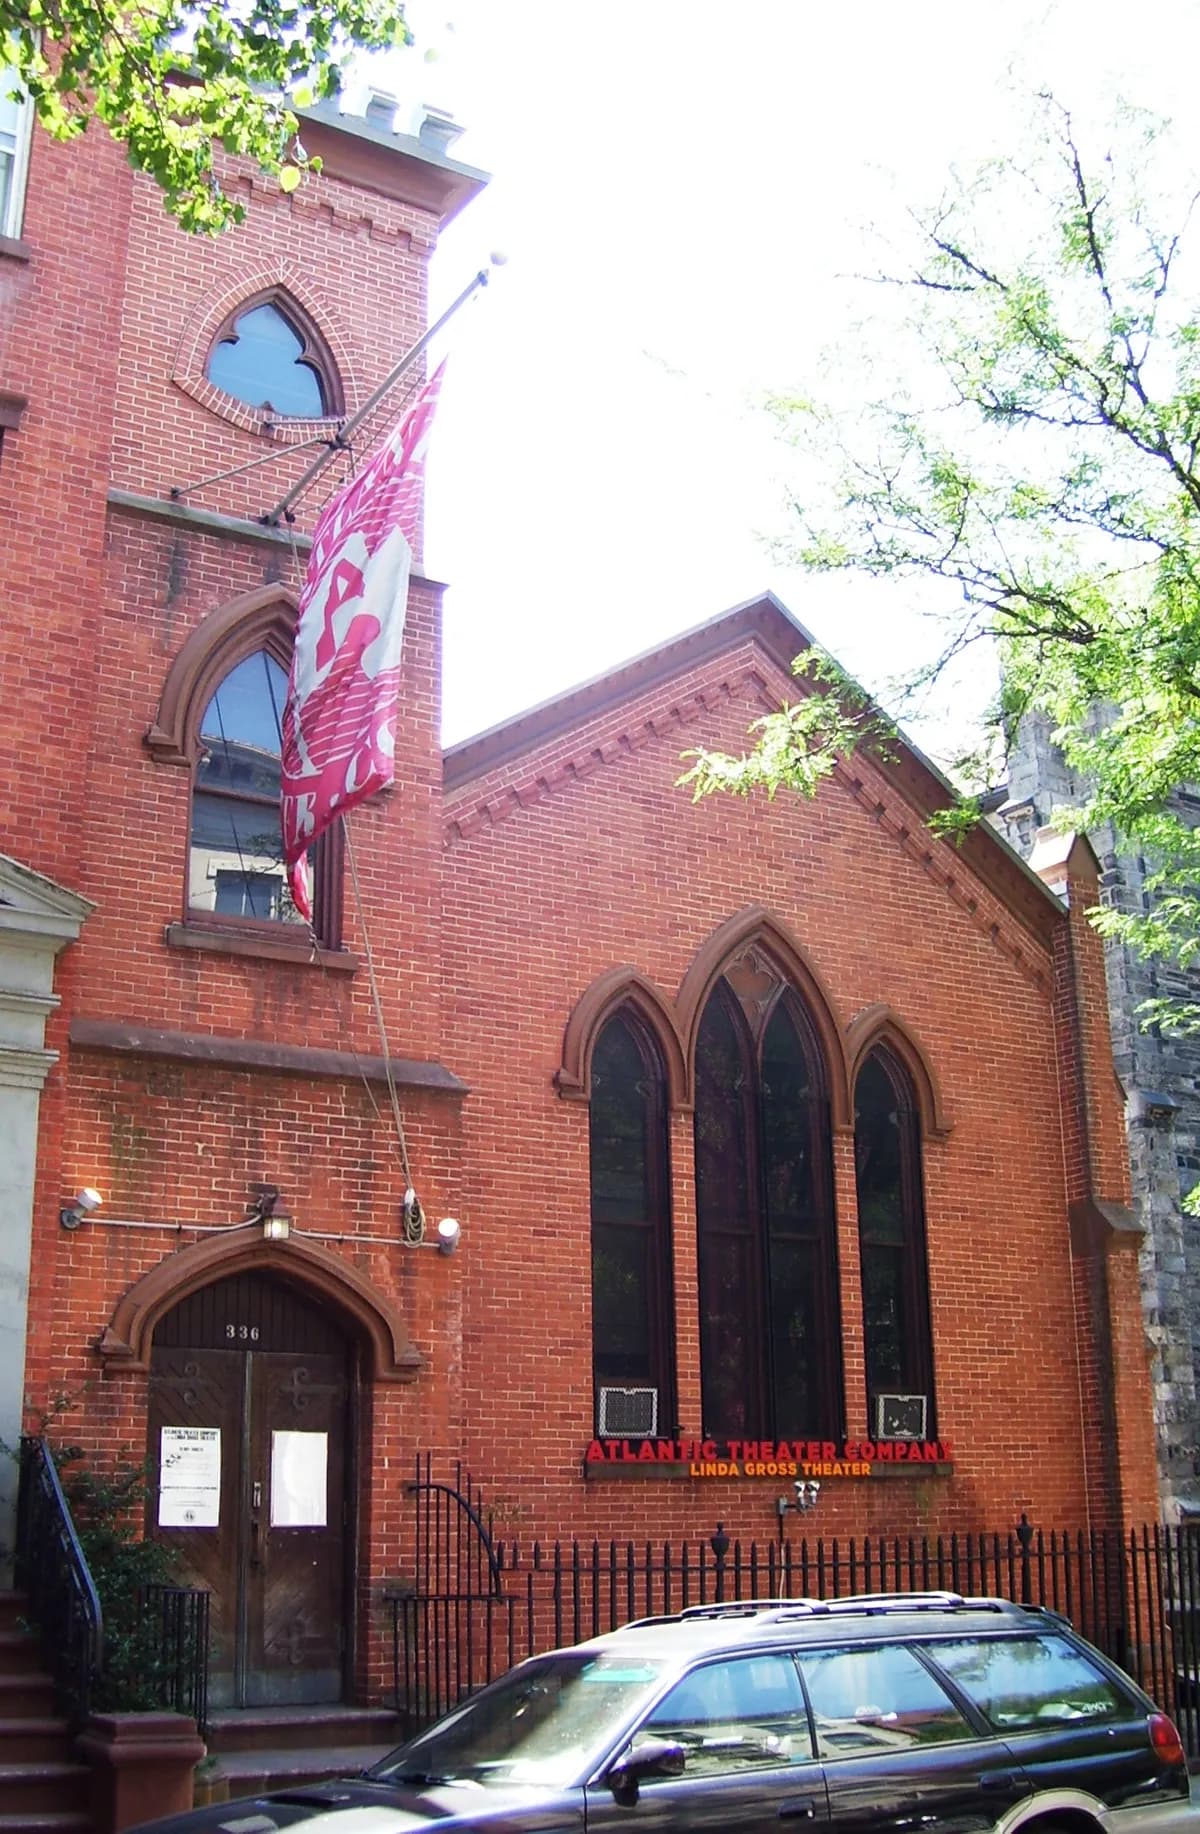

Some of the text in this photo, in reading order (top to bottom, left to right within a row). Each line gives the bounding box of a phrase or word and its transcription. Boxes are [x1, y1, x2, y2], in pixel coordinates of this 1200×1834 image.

[226, 1324, 259, 1341] 336
[586, 1439, 952, 1463] ATLANTIC THEATER COMPANY
[690, 1462, 872, 1477] LINDA GROSS THEATER
